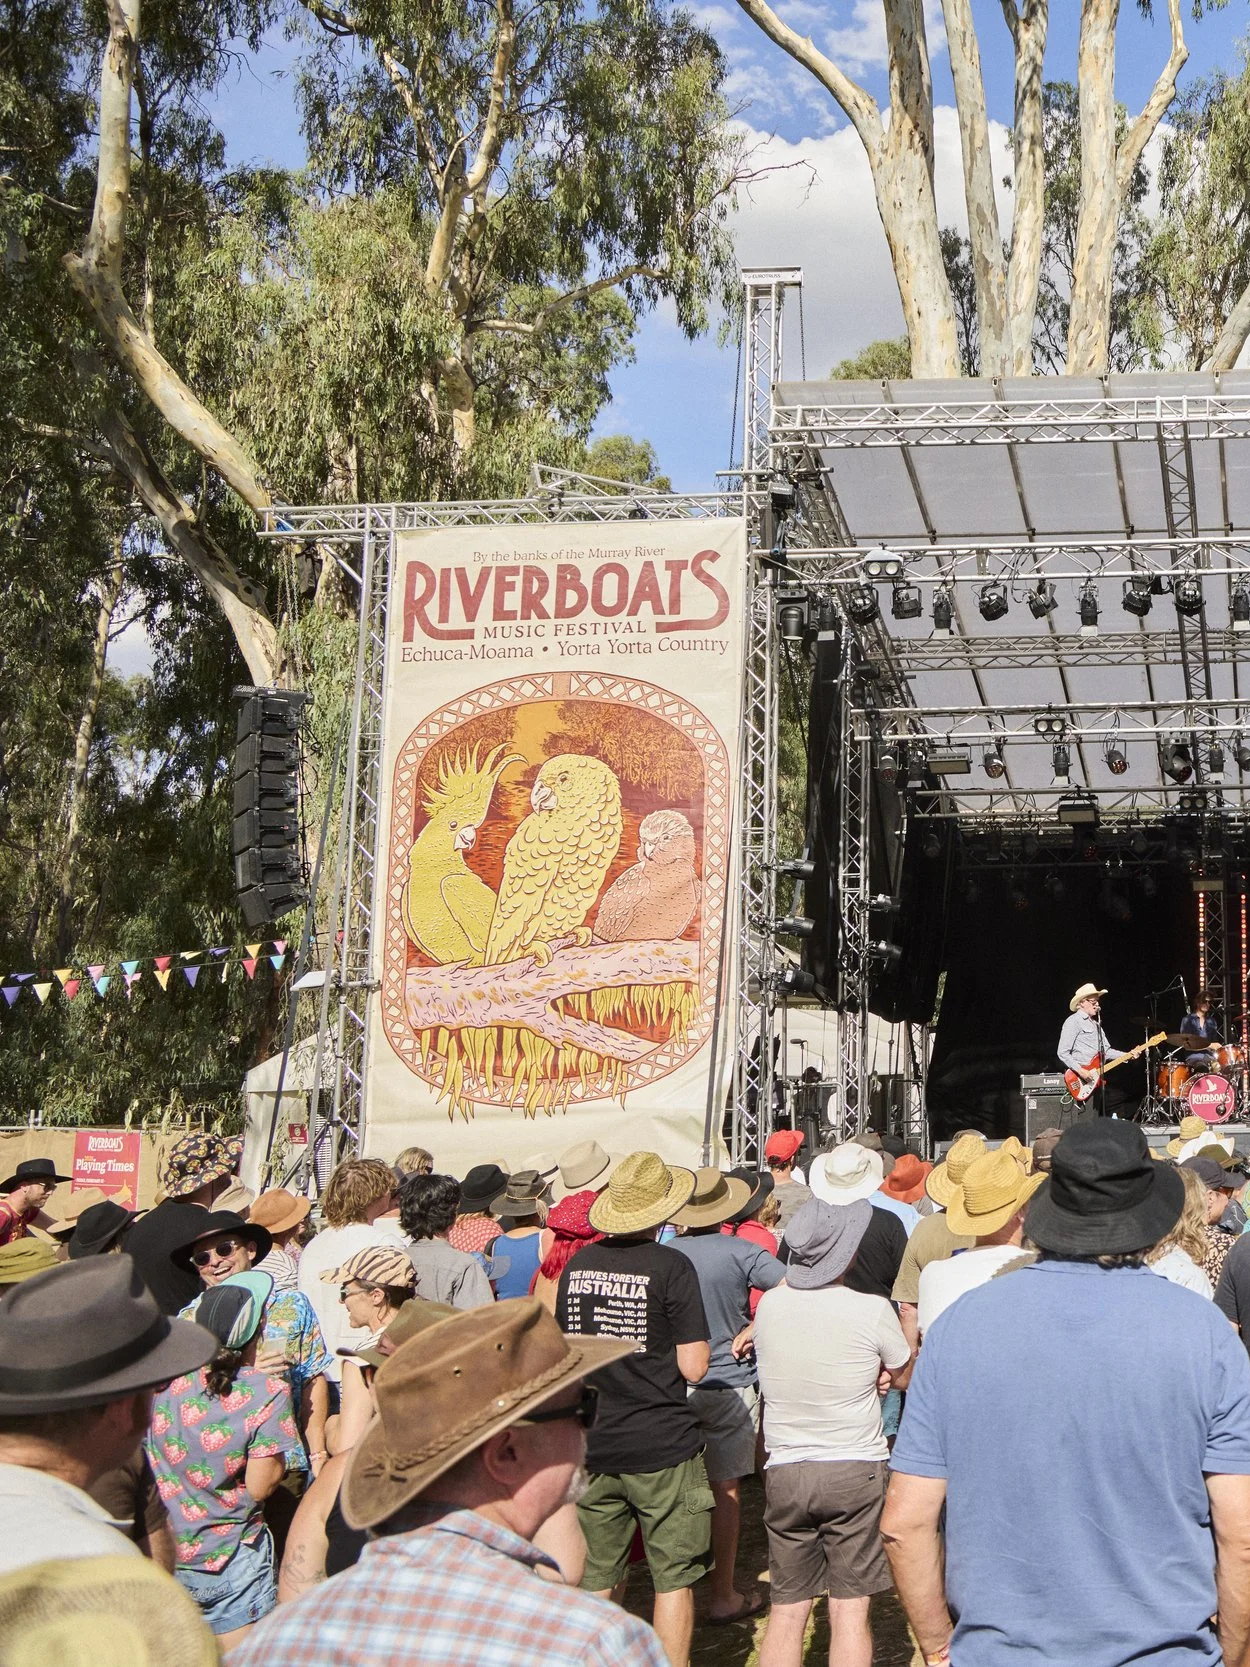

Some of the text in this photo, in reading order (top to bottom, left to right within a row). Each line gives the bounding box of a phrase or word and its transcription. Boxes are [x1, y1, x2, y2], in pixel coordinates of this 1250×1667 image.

[472, 546, 666, 564] By the banks of the Murray River
[402, 550, 730, 643] RIVERBOATS
[483, 620, 647, 639] MUSIC FESTIVAL
[401, 636, 730, 663] Echuca-Moama Yorta Yorta Country
[88, 1136, 123, 1152] RIVERBOATS
[76, 1158, 106, 1174] Playing
[107, 1159, 134, 1172] Times
[569, 1270, 650, 1286] THE HIVES FOREVER
[568, 1280, 648, 1300] AUSTRALIA
